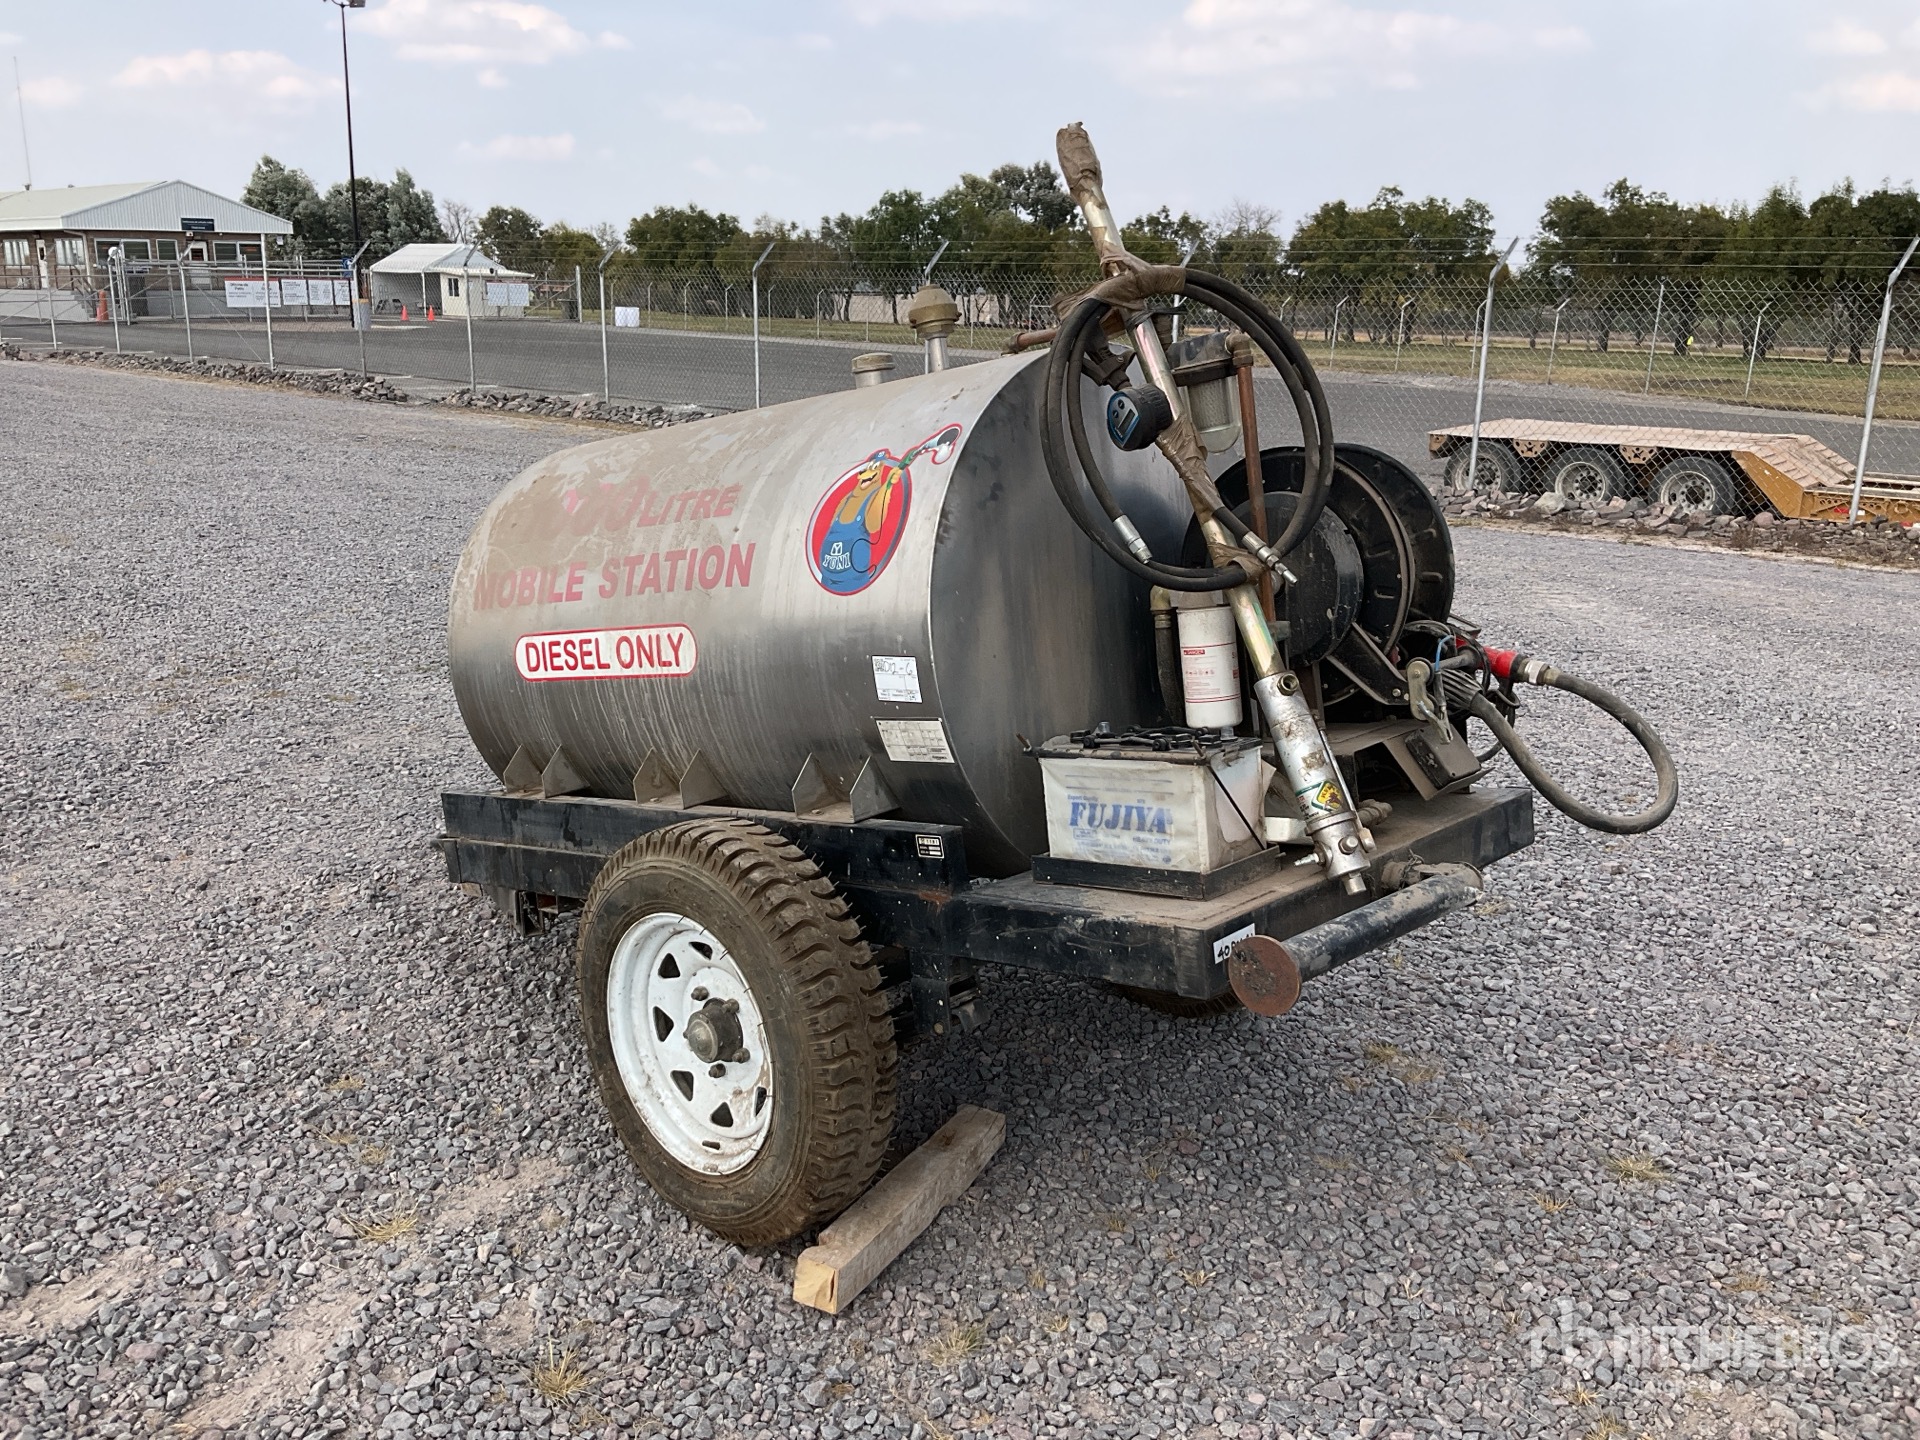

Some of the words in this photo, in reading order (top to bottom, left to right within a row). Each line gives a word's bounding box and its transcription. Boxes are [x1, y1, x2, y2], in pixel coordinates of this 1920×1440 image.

[473, 560, 588, 611] MOBILE
[598, 542, 757, 599] STATION
[525, 638, 611, 672] DIESEL
[615, 632, 684, 669] ONLY
[1069, 801, 1167, 834] FUJIYA
